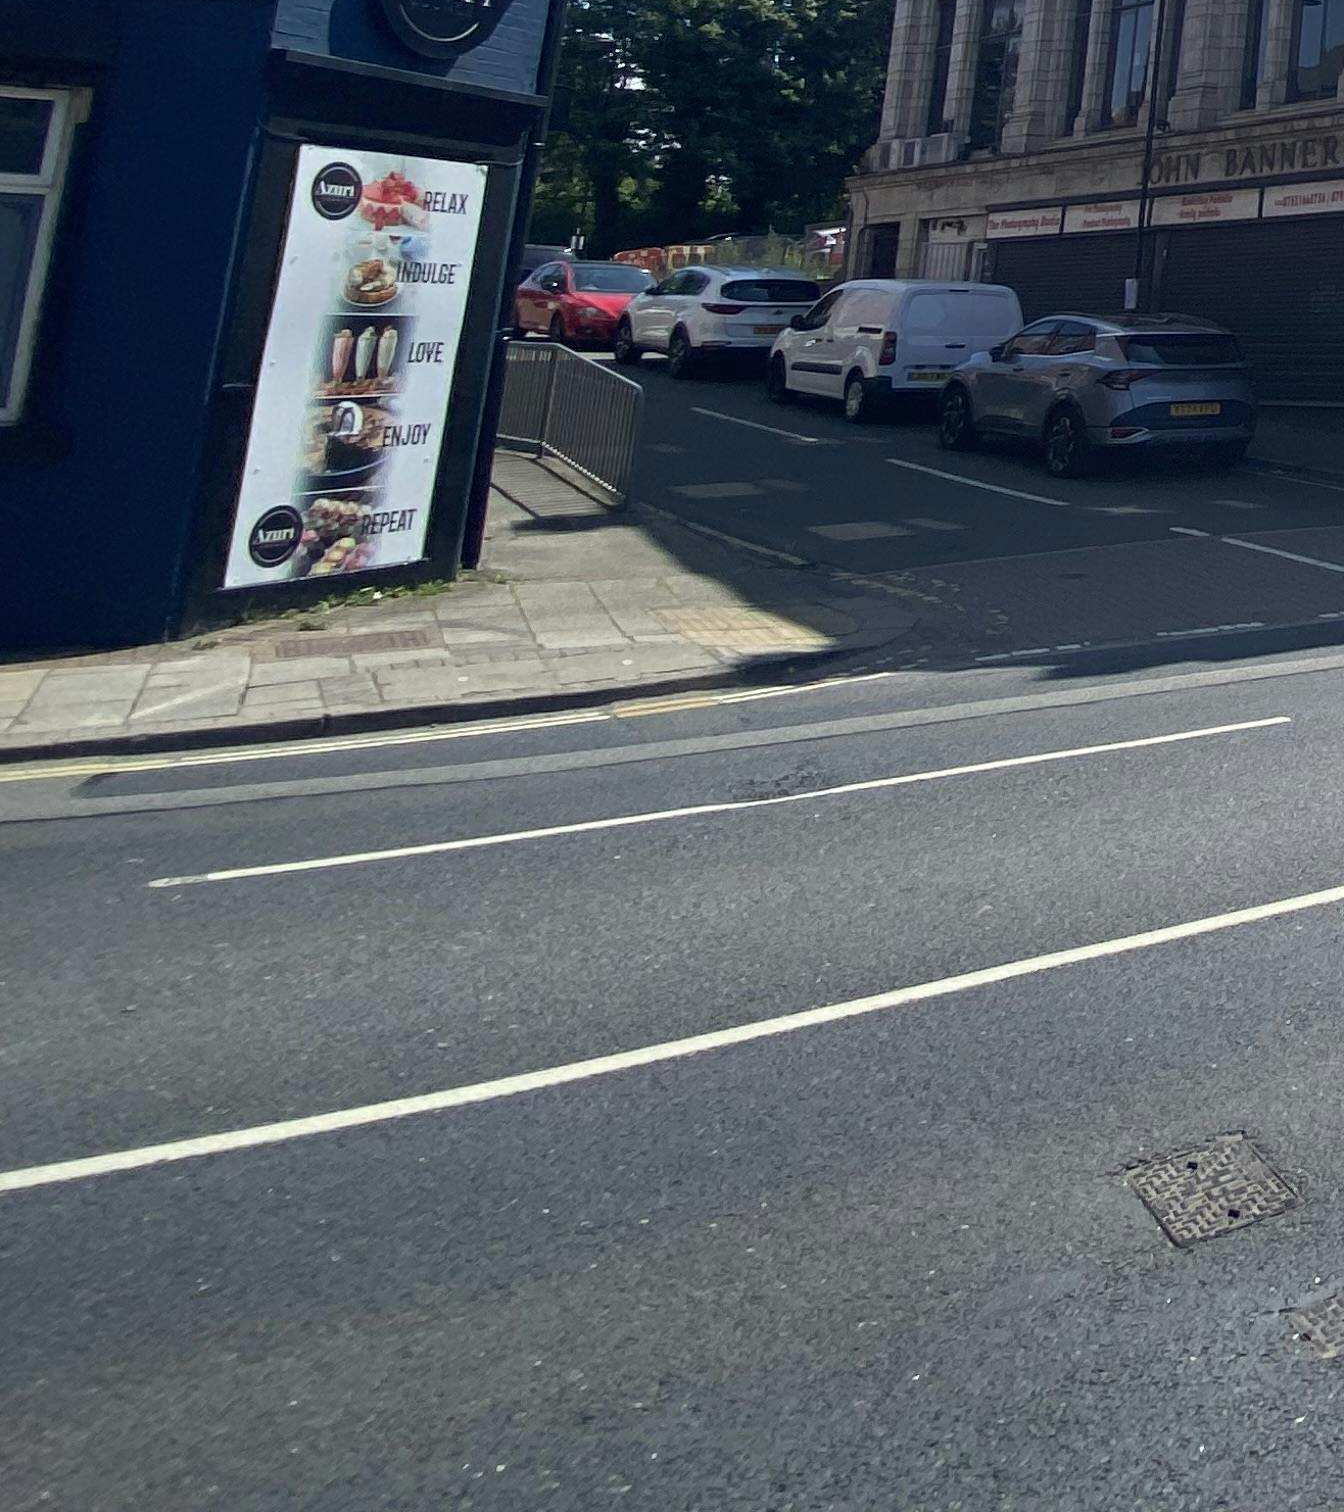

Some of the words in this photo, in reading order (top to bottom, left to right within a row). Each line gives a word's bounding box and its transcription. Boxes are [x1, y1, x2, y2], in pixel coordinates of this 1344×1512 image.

[1138, 152, 1200, 185] OHN
[1224, 135, 1340, 177] BANNER
[316, 180, 355, 197] Azuri
[423, 191, 469, 215] RELAX
[395, 261, 456, 285] INDULGE
[407, 341, 445, 364] LOVE
[382, 423, 432, 448] ENJOY
[256, 526, 295, 541] Azuri
[360, 508, 418, 536] REPEAT
